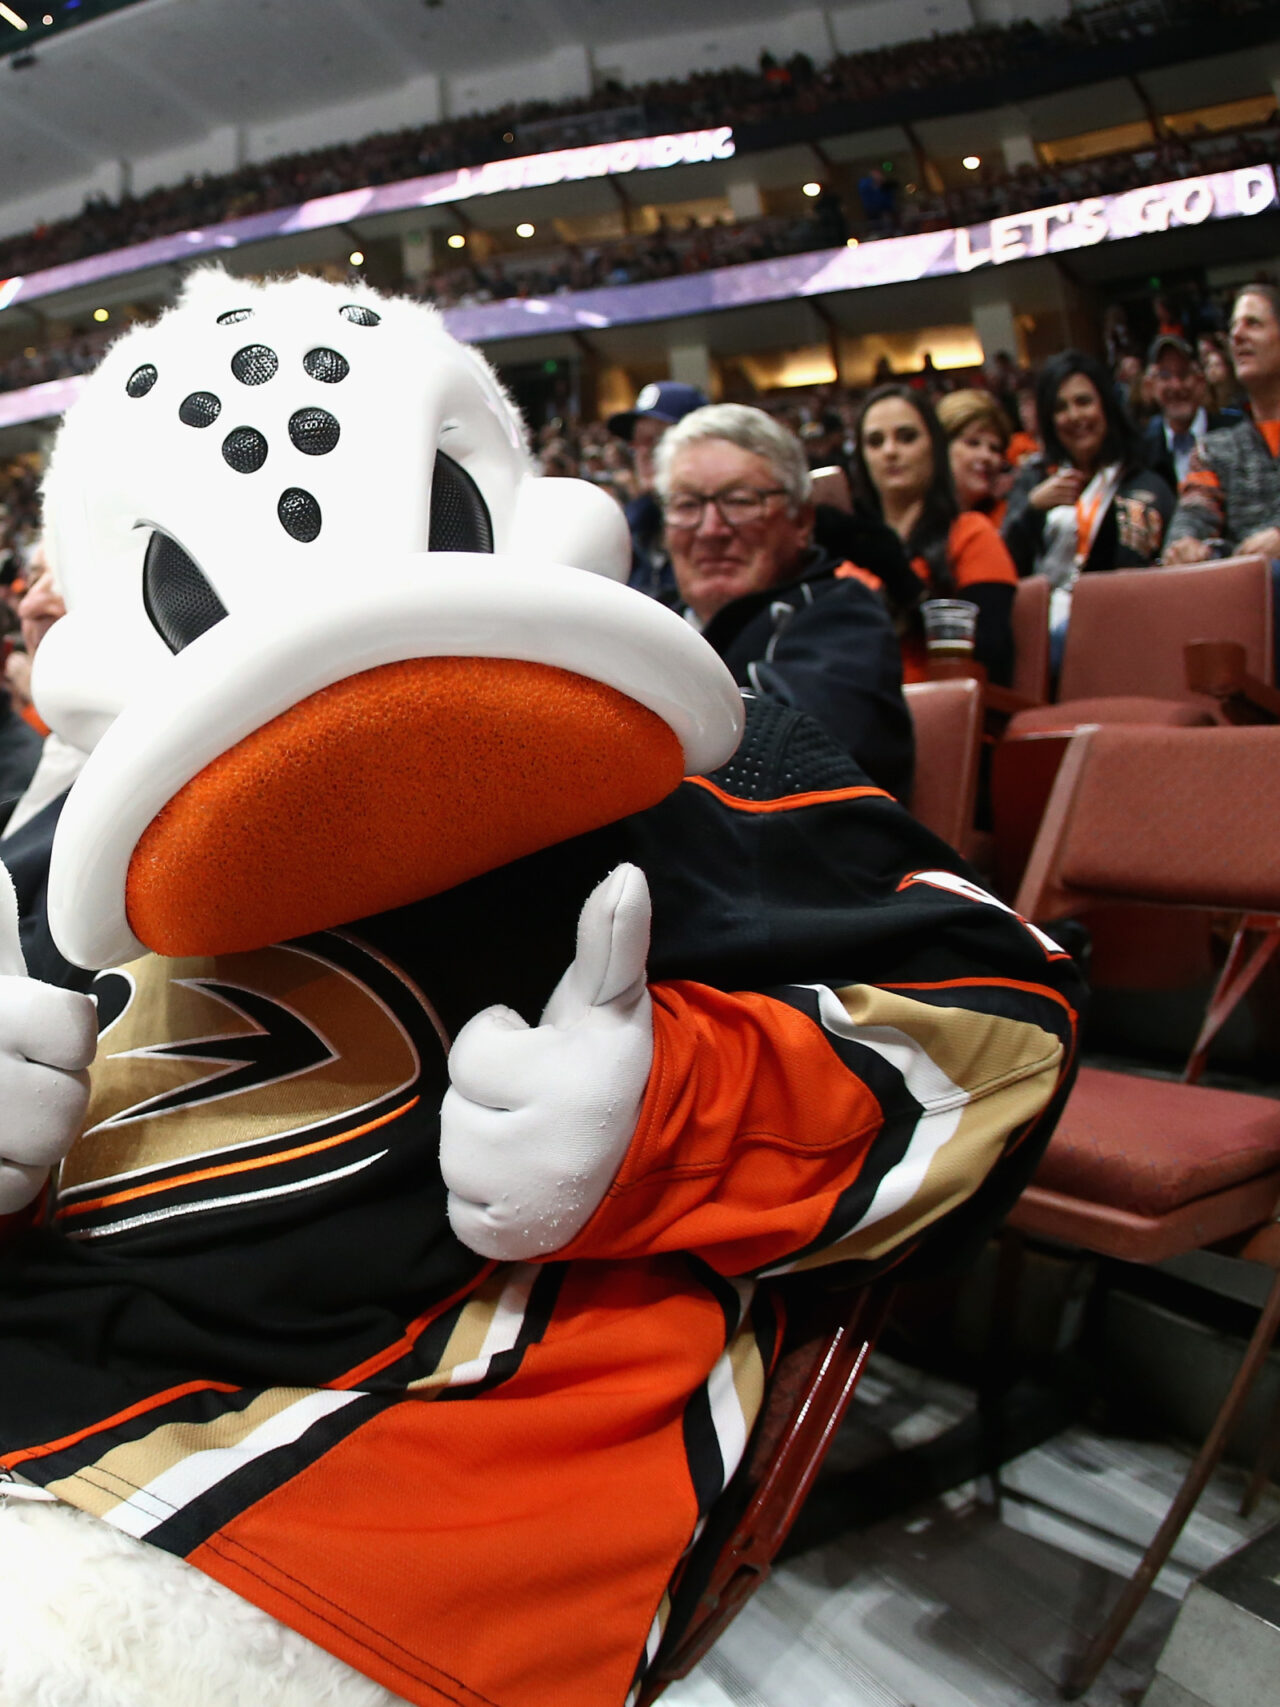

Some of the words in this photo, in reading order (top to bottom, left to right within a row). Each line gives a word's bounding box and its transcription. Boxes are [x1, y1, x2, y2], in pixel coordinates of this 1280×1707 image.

[954, 199, 1110, 271] LET'S
[1125, 177, 1214, 233] GO
[1232, 167, 1275, 215] D
